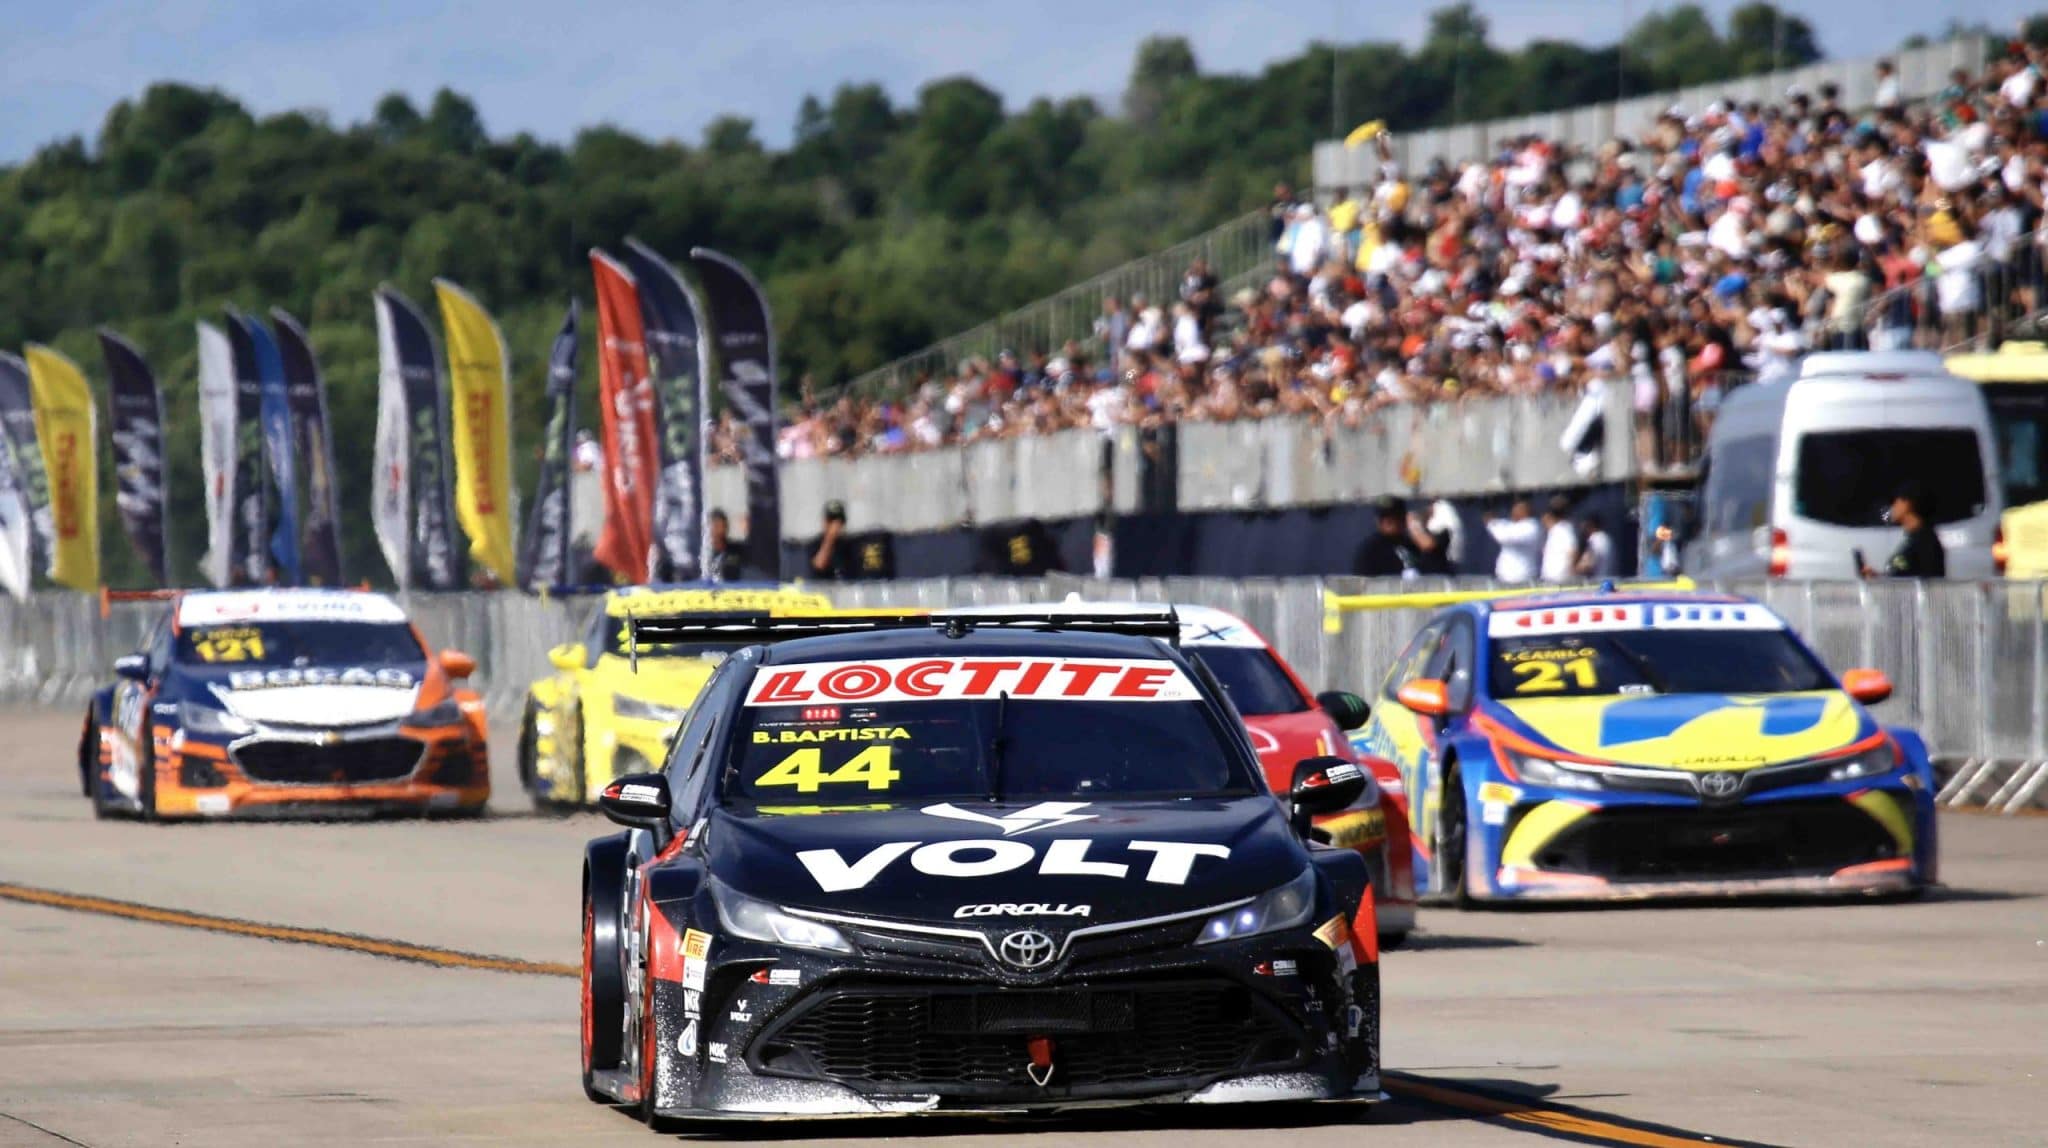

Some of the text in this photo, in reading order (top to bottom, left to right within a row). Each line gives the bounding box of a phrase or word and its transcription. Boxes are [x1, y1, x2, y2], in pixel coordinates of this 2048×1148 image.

[196, 636, 265, 662] 121
[752, 660, 1175, 703] LOCTITE
[1512, 657, 1597, 692] 21
[752, 727, 911, 744] B.BAPTISTA
[755, 745, 901, 792] 44
[796, 839, 1231, 892] VOLT
[953, 903, 1091, 919] COROLLA
